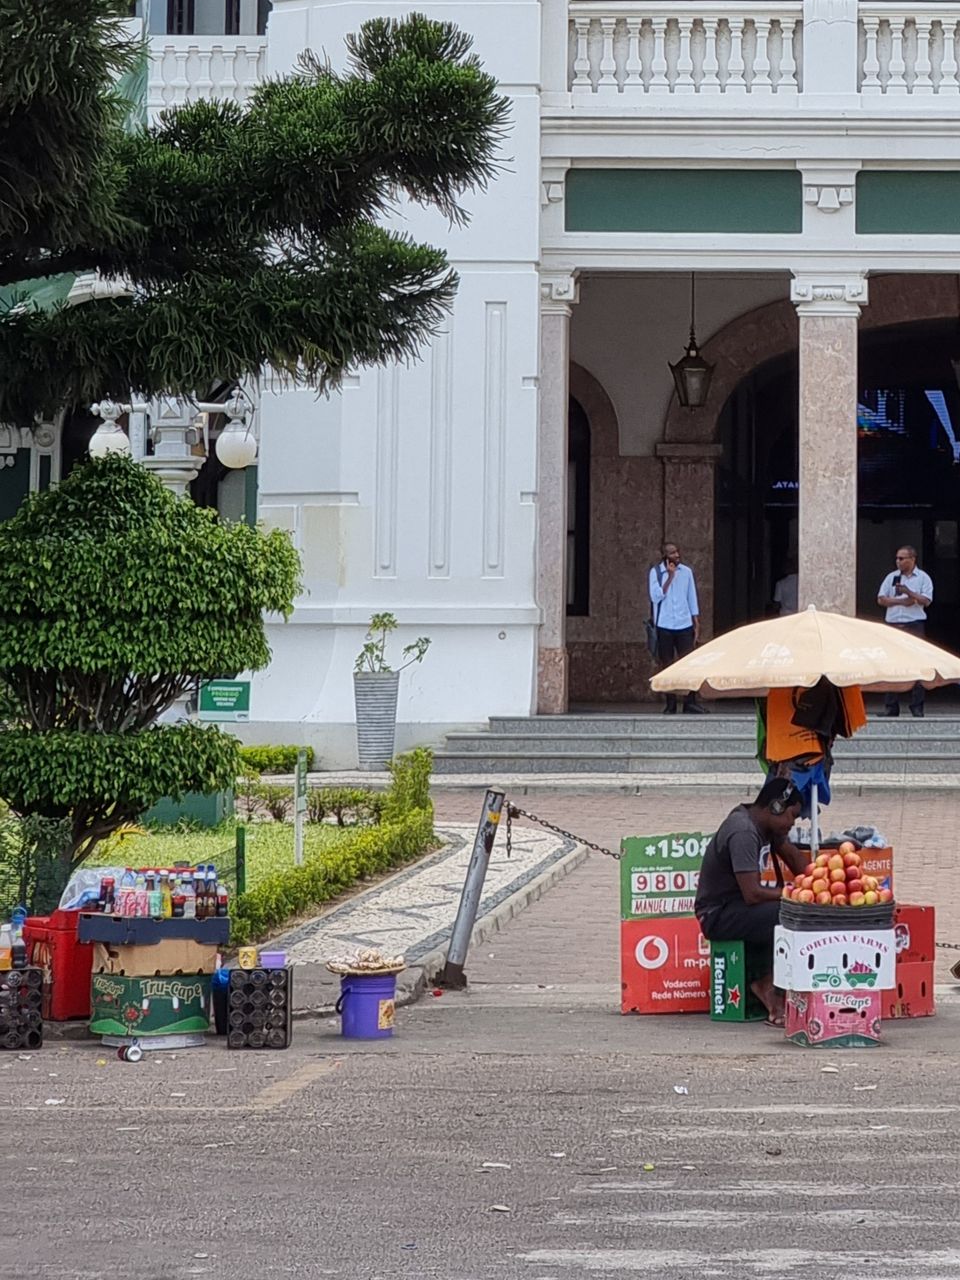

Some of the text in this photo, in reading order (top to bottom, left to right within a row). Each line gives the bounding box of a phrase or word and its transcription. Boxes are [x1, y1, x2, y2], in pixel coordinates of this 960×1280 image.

[634, 898, 667, 913] MANUEL
[800, 935, 848, 957] CORTINA
[851, 935, 889, 954] FARMS
[140, 979, 202, 1005] Tru-Cape
[663, 980, 701, 989] Vodacom
[652, 991, 671, 1001] Rede
[673, 990, 707, 1000] Número
[823, 992, 871, 1008] Tru-Cape
